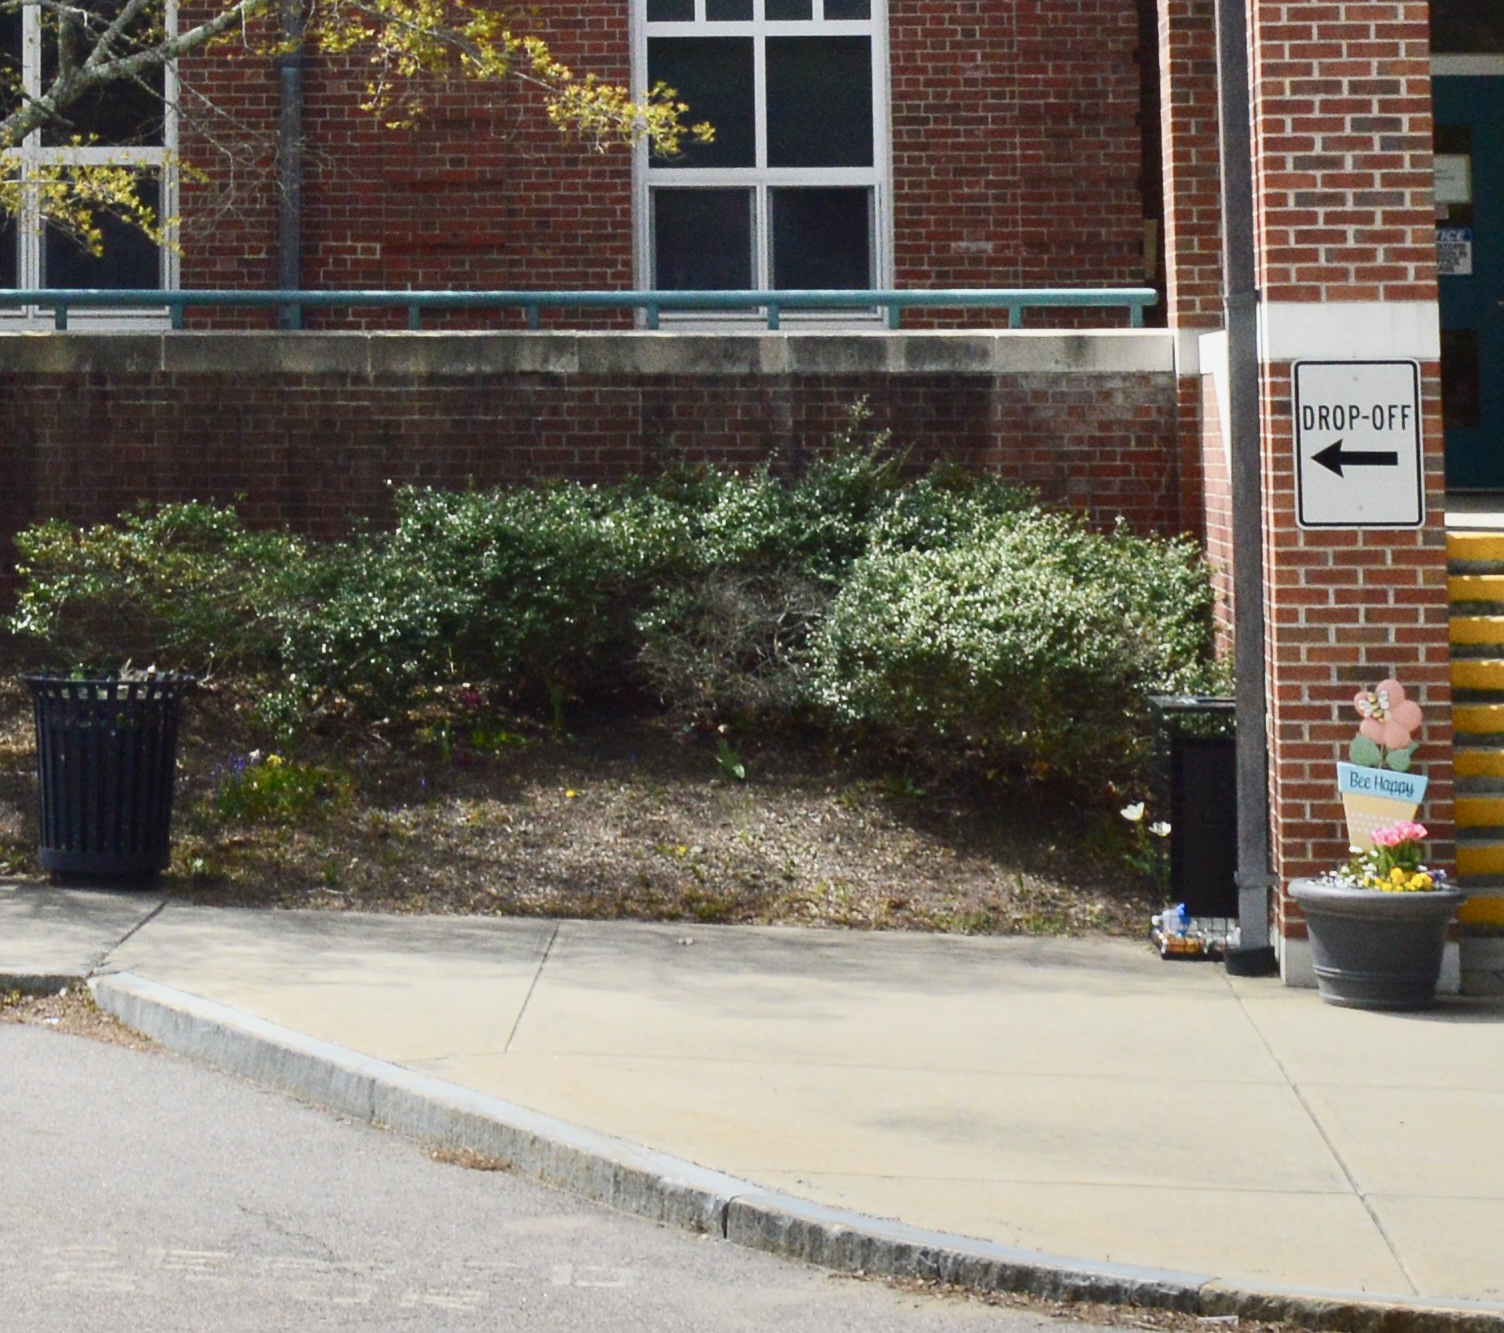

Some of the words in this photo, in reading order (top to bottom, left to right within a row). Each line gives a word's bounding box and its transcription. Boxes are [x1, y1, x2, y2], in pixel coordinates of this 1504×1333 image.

[1302, 404, 1412, 431] DROP-OFF
[1349, 771, 1371, 789] Bee
[1374, 774, 1415, 798] Happy
